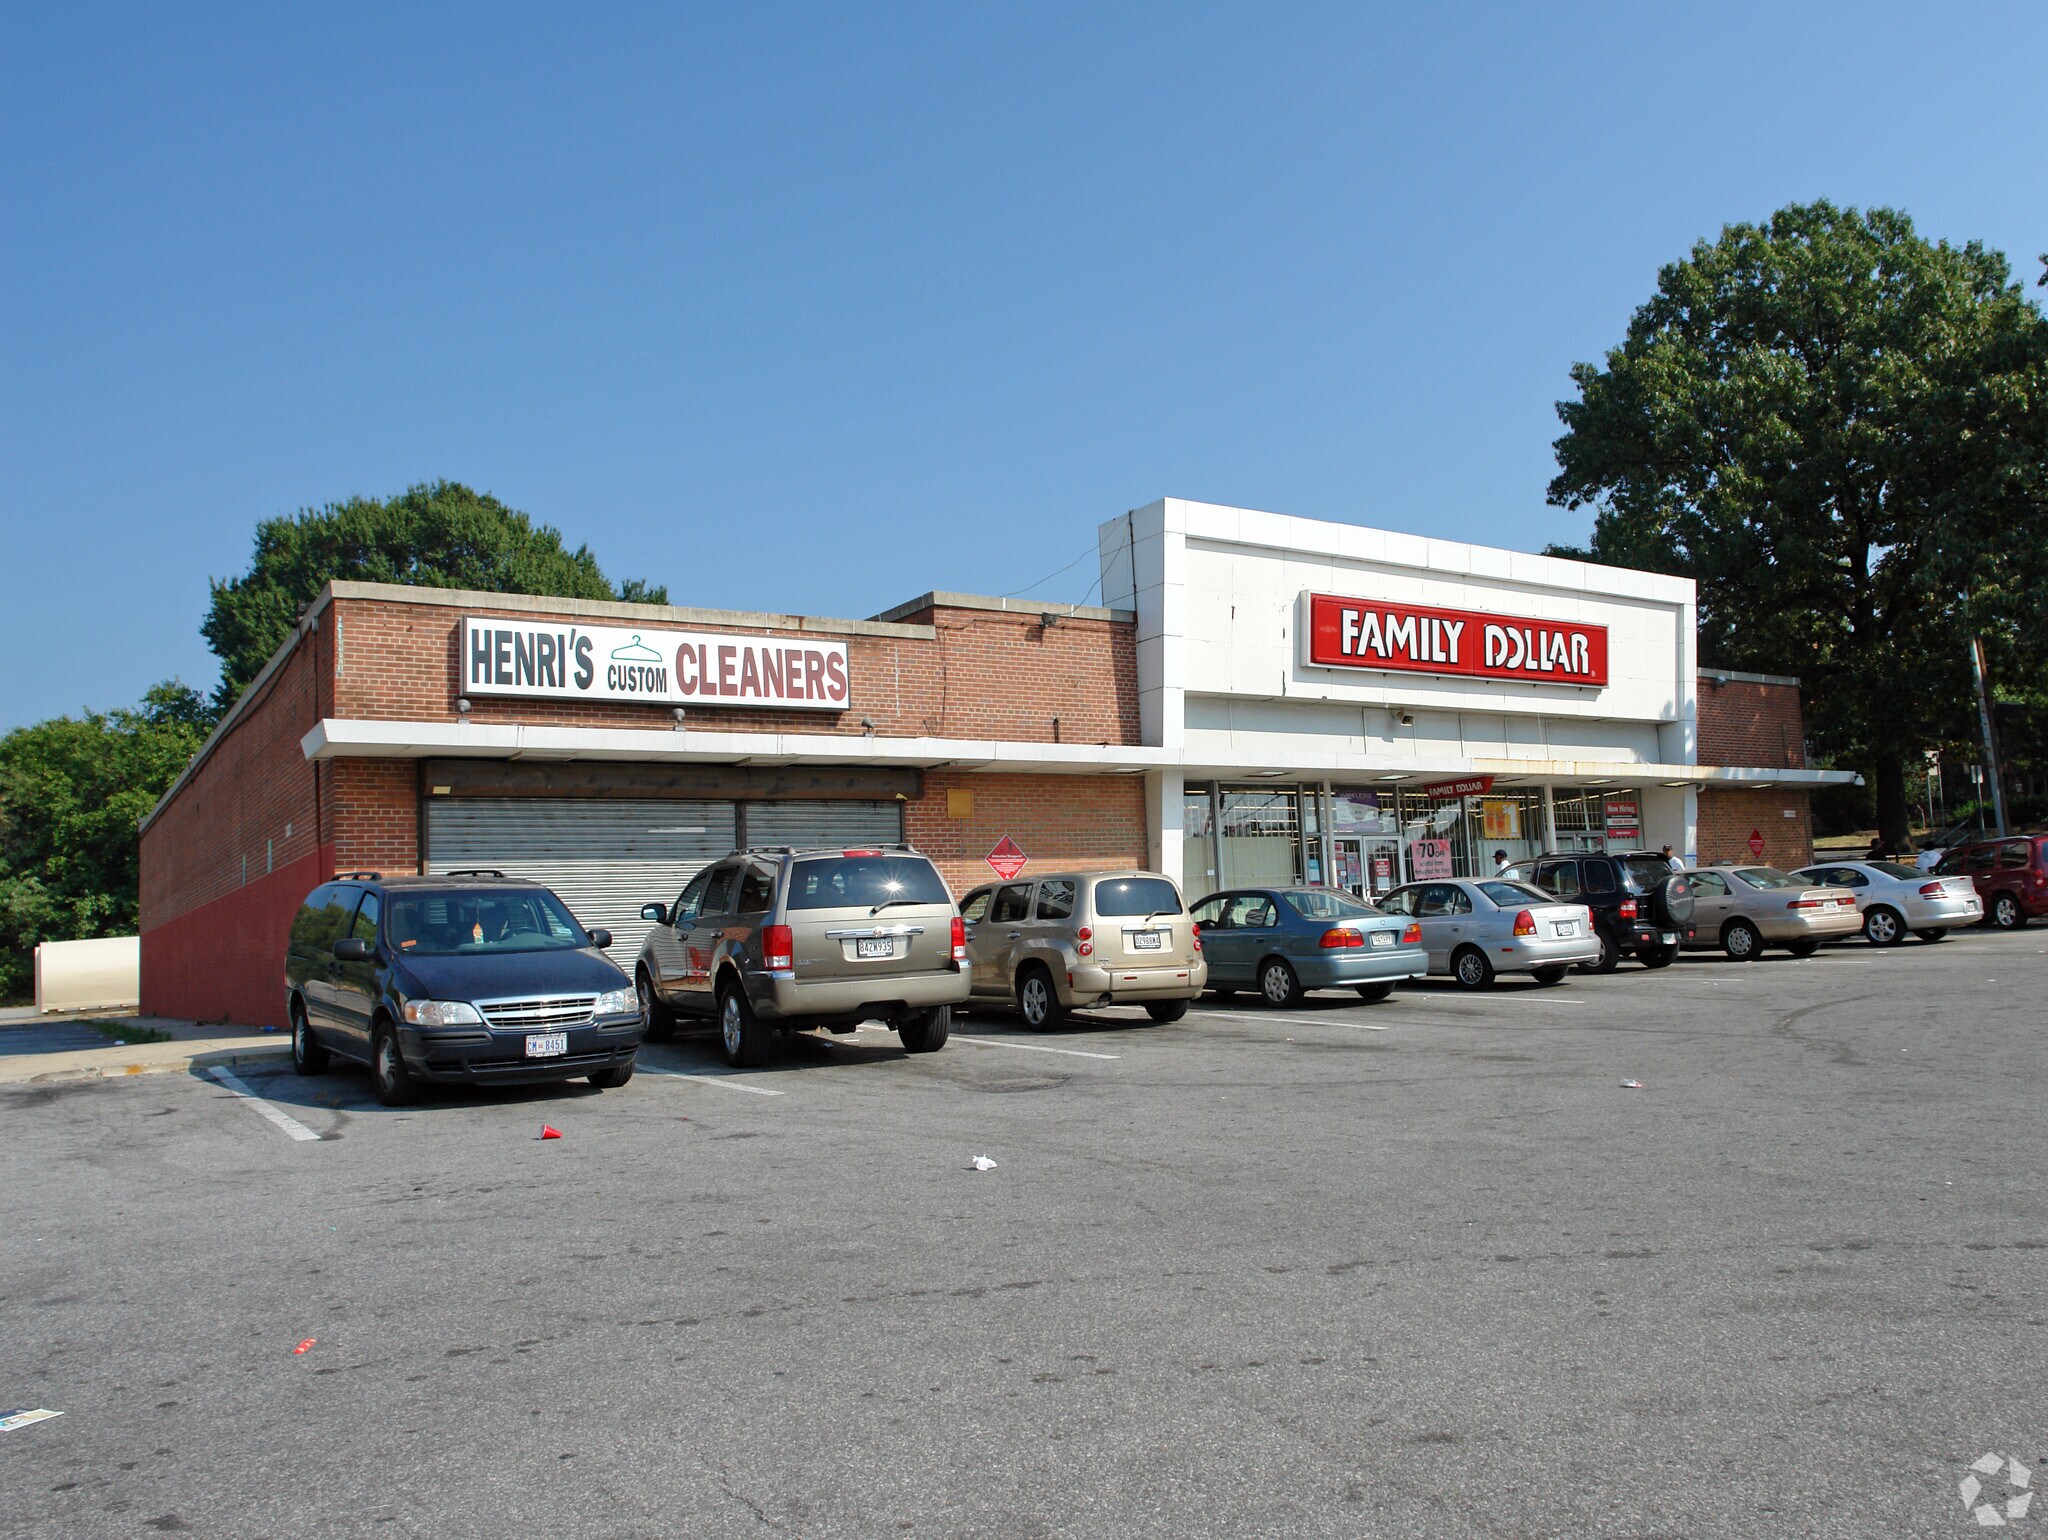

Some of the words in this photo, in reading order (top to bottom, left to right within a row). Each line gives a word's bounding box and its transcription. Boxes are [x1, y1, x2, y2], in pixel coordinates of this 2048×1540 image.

[1341, 608, 1466, 663] FAMILY
[1484, 623, 1590, 675] DOLLAR
[471, 628, 593, 690] HENRI'S
[607, 663, 668, 694] CUSTOM
[675, 642, 847, 702] CLEANERS
[1429, 785, 1454, 796] FAMILY
[1456, 781, 1483, 793] DOLLAR
[545, 1039, 564, 1051] 8451
